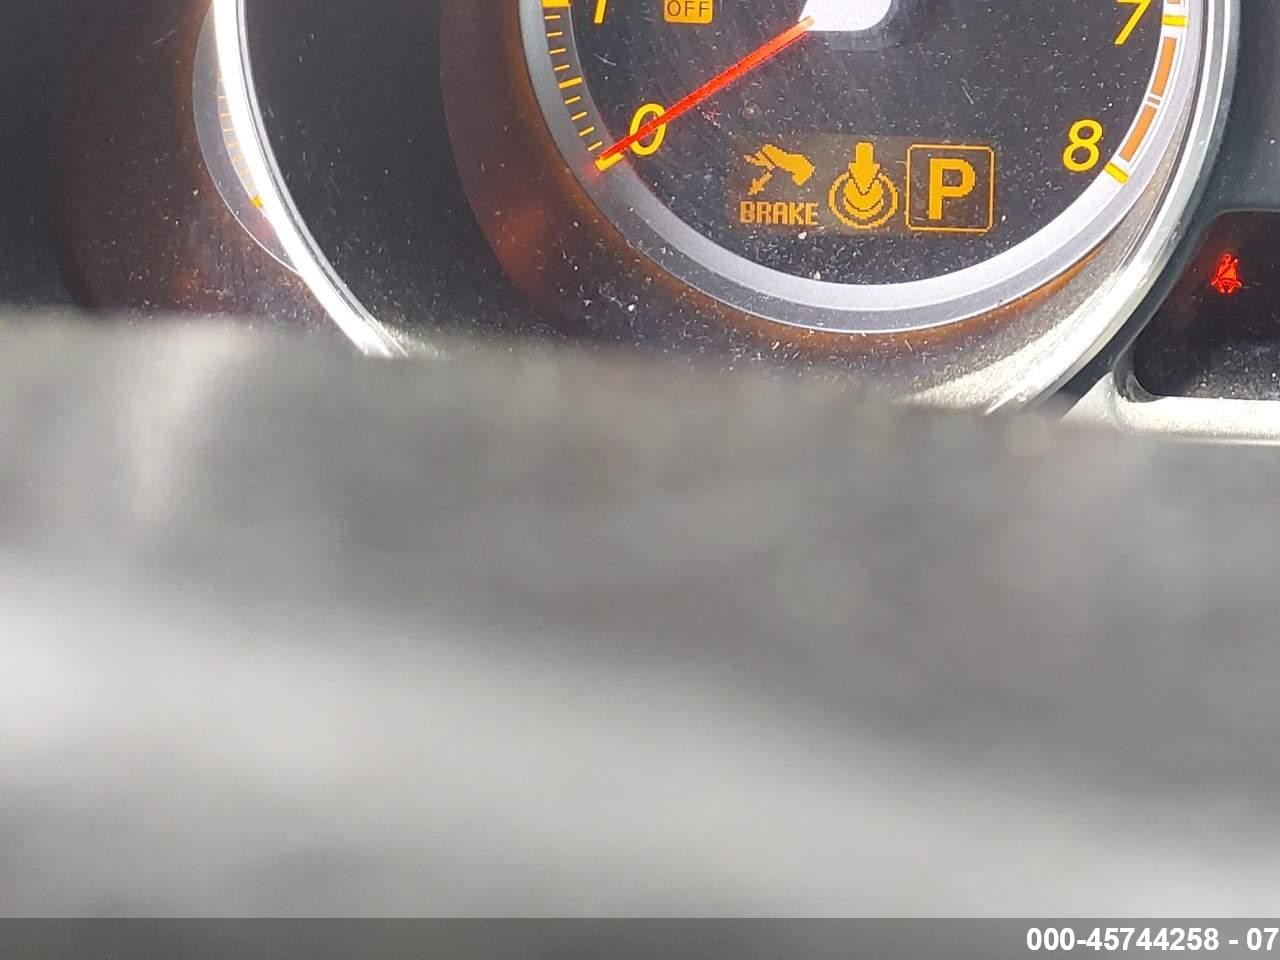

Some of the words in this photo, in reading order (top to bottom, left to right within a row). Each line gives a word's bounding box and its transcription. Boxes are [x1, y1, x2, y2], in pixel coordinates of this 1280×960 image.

[666, 0, 712, 17] OFF
[629, 103, 667, 156] 0
[1062, 119, 1104, 172] 8
[739, 200, 818, 226] BRAKE
[928, 158, 976, 220] P
